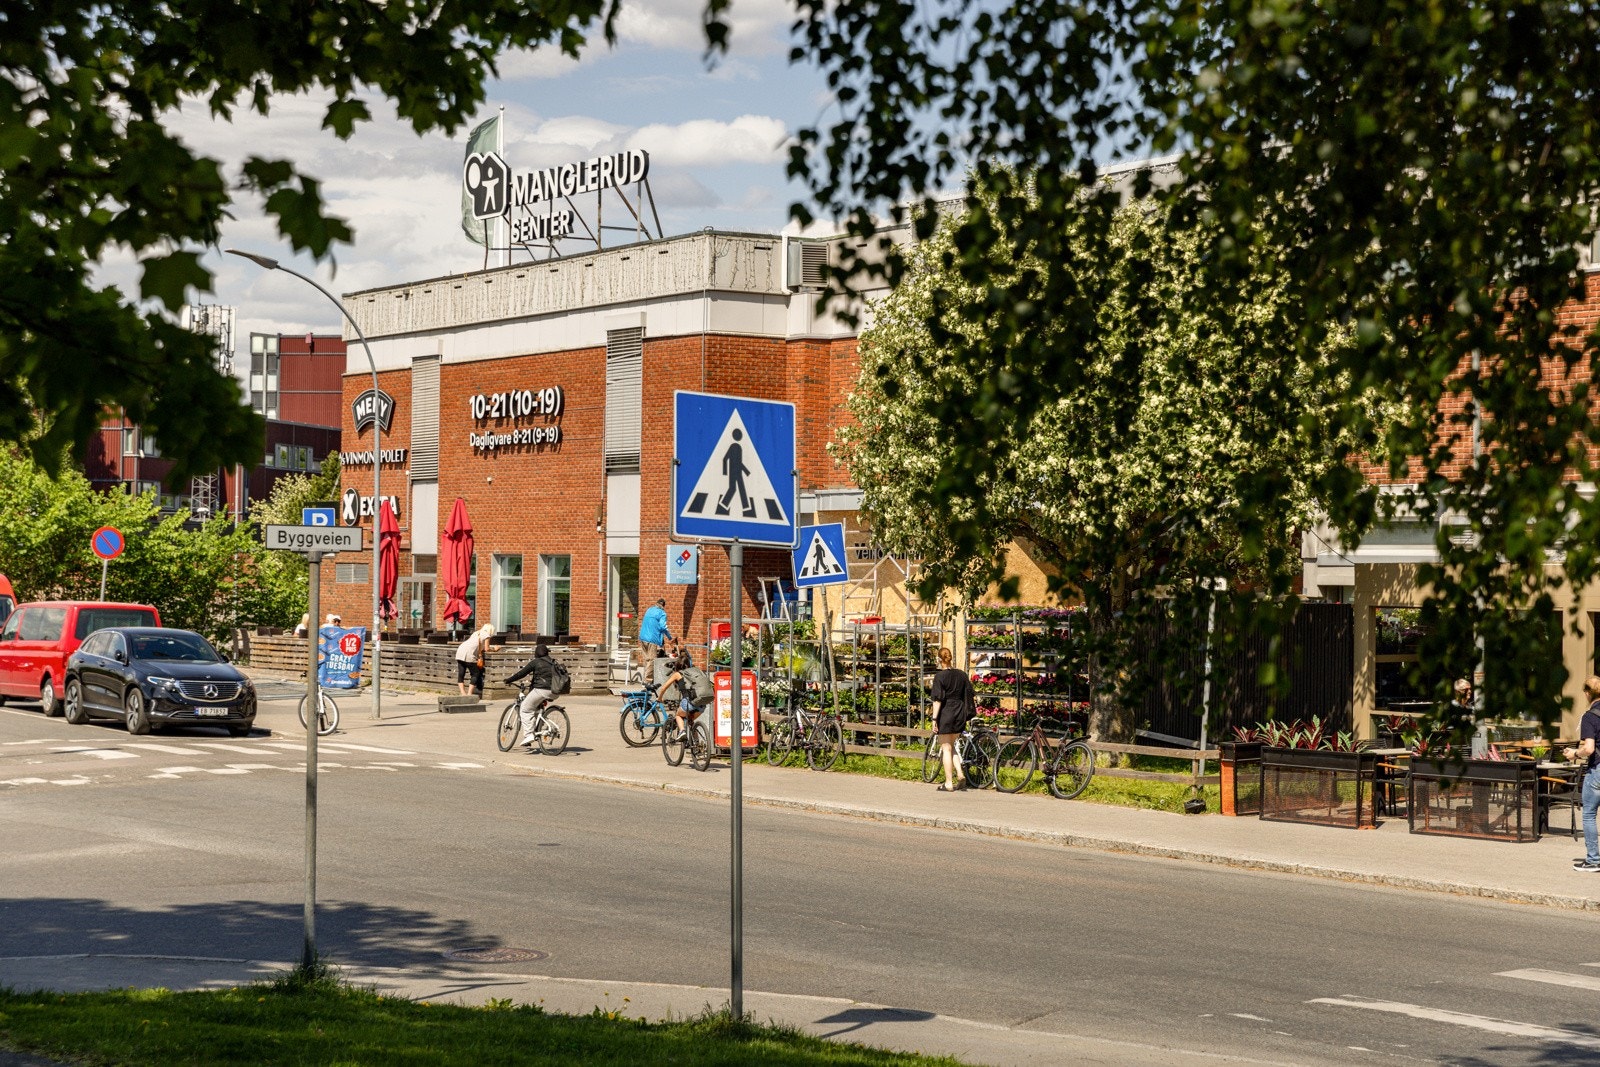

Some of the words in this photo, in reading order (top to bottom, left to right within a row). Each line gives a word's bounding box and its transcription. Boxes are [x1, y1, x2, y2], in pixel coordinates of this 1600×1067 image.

[511, 150, 647, 206] MANGLERUD
[511, 210, 571, 242] SENTER
[469, 393, 506, 419] 10-21
[510, 386, 560, 419] (10-19)
[470, 431, 512, 450] Dagligvare
[513, 429, 531, 444] 8-21
[533, 426, 558, 444] (9-19)
[345, 449, 404, 465] VINMONPOLET
[278, 530, 351, 547] Byggveien
[326, 661, 354, 671] TUESDAY
[330, 653, 352, 662] CRAZY
